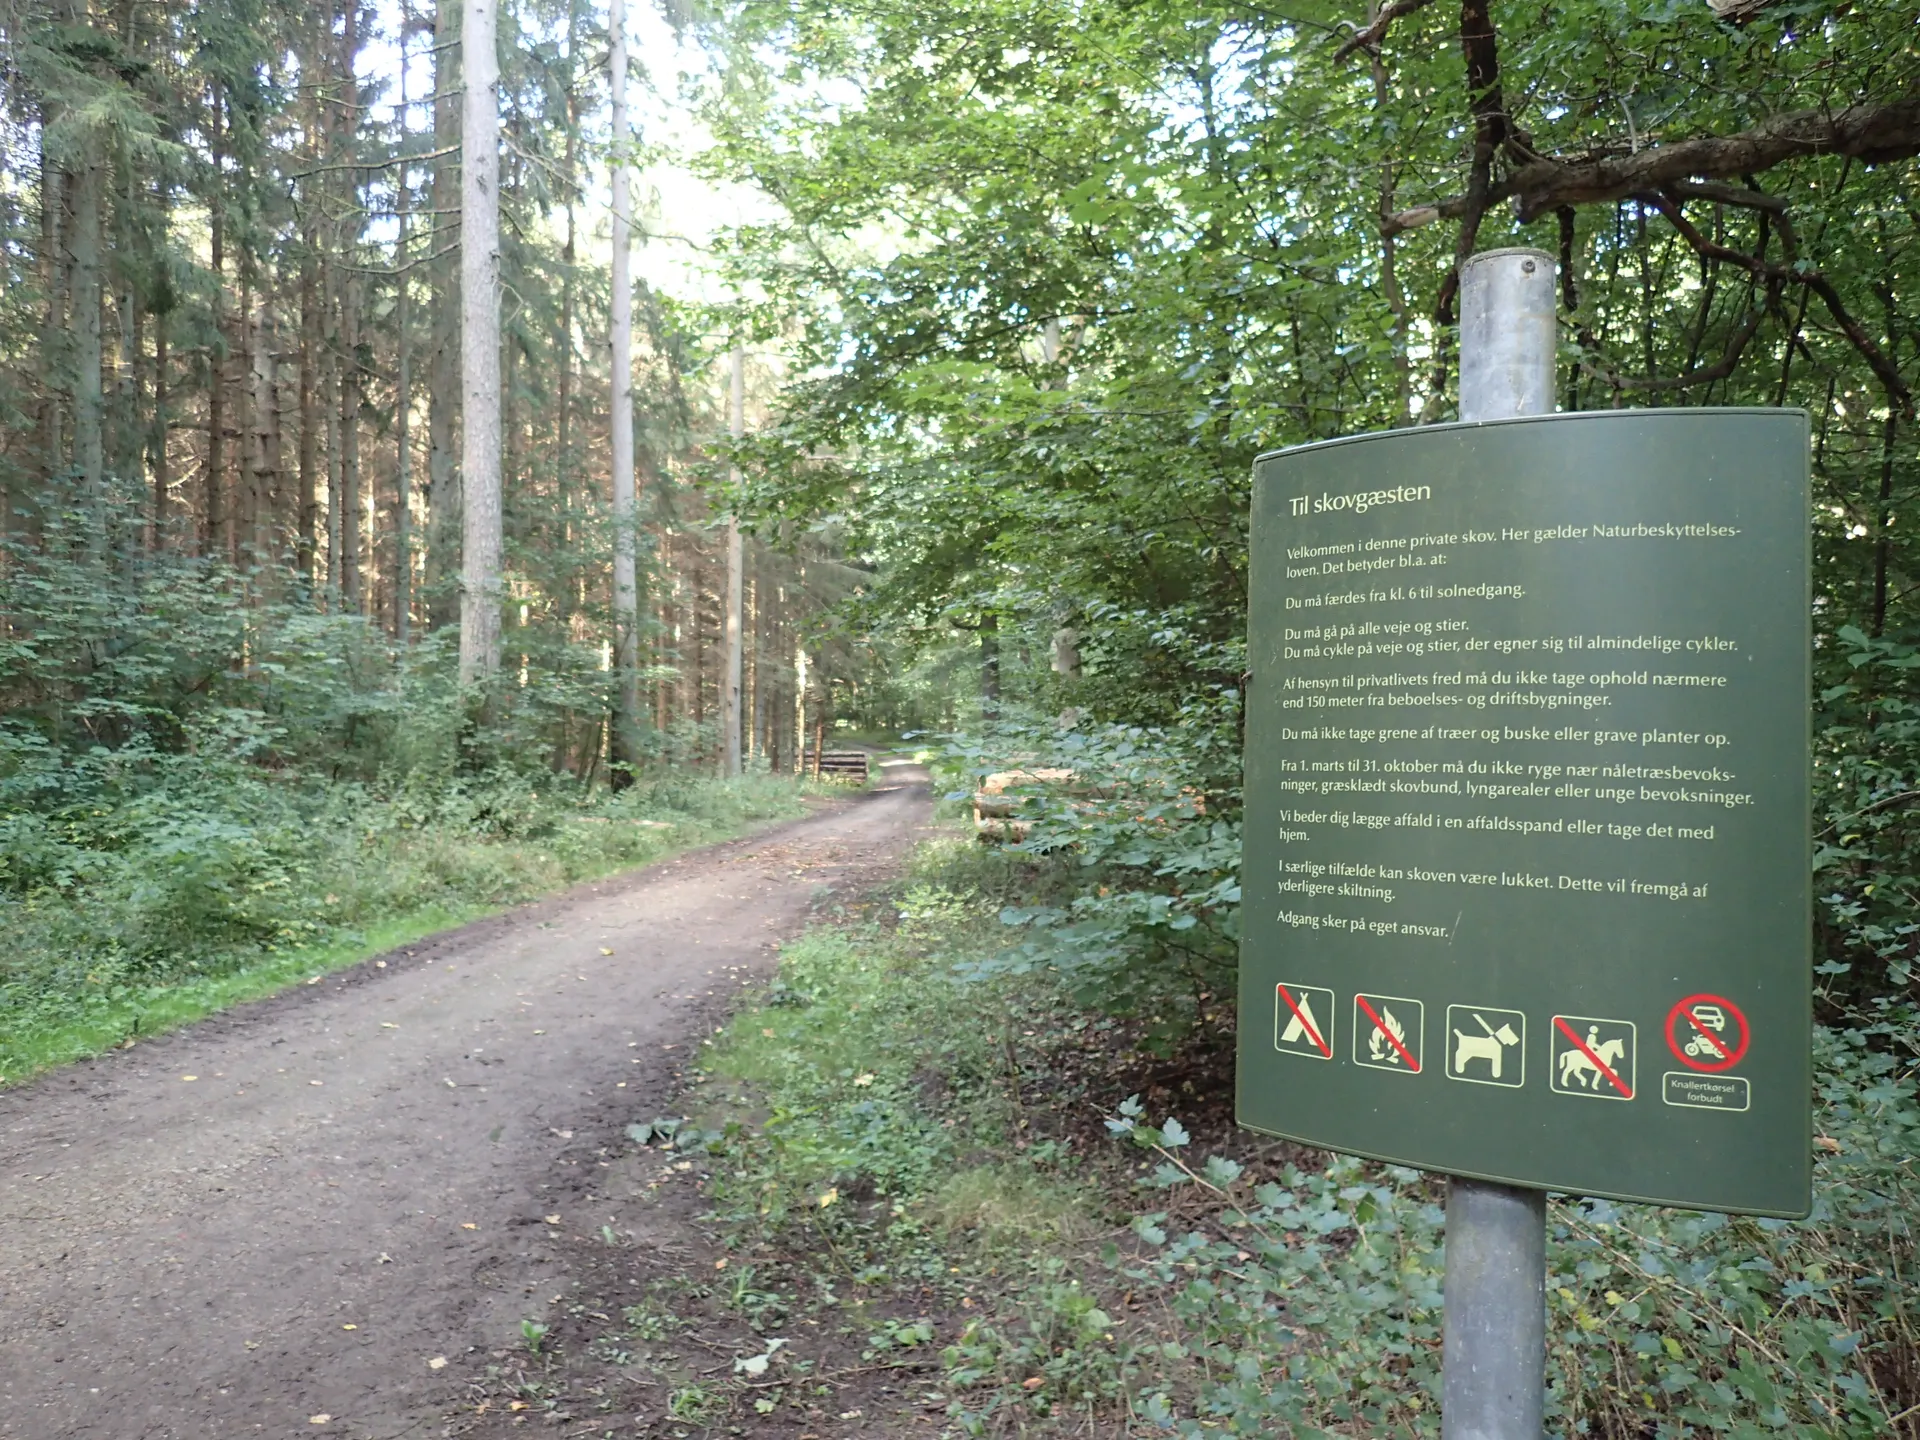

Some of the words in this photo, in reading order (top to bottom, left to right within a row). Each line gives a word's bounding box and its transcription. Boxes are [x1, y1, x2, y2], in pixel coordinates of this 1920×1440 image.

[1289, 496, 1308, 516] Til
[1314, 486, 1430, 513] skovgæsten
[1287, 544, 1354, 559] Velkommen
[1365, 538, 1406, 550] denne
[1411, 534, 1457, 550] private
[1462, 530, 1496, 543] skov.
[1502, 528, 1529, 540] Her
[1534, 525, 1588, 543] gælder
[1594, 523, 1741, 540] Naturbeskyttelses-
[1287, 567, 1319, 578] loven.
[1323, 562, 1343, 574] Det
[1347, 557, 1395, 573] betyder
[1400, 554, 1426, 567] bl.a.
[1430, 554, 1446, 565] at:
[1286, 598, 1301, 609] Du
[1305, 595, 1321, 607] må
[1325, 591, 1365, 605] færdes
[1370, 589, 1386, 601] fra
[1391, 588, 1404, 600] kl.
[1409, 588, 1416, 599] 6
[1420, 585, 1432, 598] til
[1438, 583, 1525, 599] solnedgang.
[1285, 629, 1300, 640] Du
[1304, 626, 1320, 638] må
[1324, 625, 1337, 641] gå
[1340, 624, 1354, 639] på
[1358, 622, 1380, 635] alle
[1384, 621, 1410, 636] veje
[1415, 623, 1432, 635] og
[1436, 619, 1469, 631] stier.
[1285, 647, 1300, 658] Du
[1304, 645, 1320, 657] må
[1323, 643, 1354, 659] cykle
[1358, 642, 1372, 658] på
[1376, 641, 1402, 656] veje
[1407, 643, 1423, 656] og
[1428, 639, 1460, 652] stier,
[1465, 637, 1489, 650] der
[1494, 640, 1537, 654] egner
[1542, 637, 1563, 653] sig
[1568, 636, 1582, 649] til
[1588, 635, 1681, 653] almindelige
[1686, 636, 1737, 653] cykler.
[1283, 677, 1295, 689] Af
[1298, 677, 1338, 691] hensyn
[1342, 675, 1353, 687] til
[1358, 673, 1428, 690] privatlivets
[1433, 671, 1461, 684] fred
[1466, 672, 1487, 684] må
[1492, 671, 1510, 684] du
[1517, 671, 1547, 684] ikke
[1553, 673, 1585, 688] tage
[1590, 671, 1647, 688] ophold
[1653, 676, 1726, 686] nærmere
[1283, 696, 1303, 708] end
[1307, 696, 1325, 707] 150
[1329, 696, 1364, 706] meter
[1368, 693, 1384, 705] fra
[1389, 692, 1463, 705] beboelses-
[1467, 696, 1485, 709] og
[1490, 691, 1611, 709] driftsbygninger.
[1283, 728, 1298, 739] Du
[1301, 727, 1317, 739] må
[1322, 727, 1345, 739] ikke
[1349, 729, 1375, 743] tage
[1379, 730, 1417, 743] grene
[1421, 726, 1434, 738] af
[1438, 728, 1477, 739] træer
[1481, 730, 1499, 743] og
[1505, 726, 1549, 740] buske
[1555, 727, 1589, 740] eller
[1594, 731, 1637, 745] grave
[1643, 729, 1700, 746] planter
[1705, 735, 1730, 748] op.
[1282, 760, 1296, 771] Fra
[1300, 760, 1308, 771] 1.
[1312, 761, 1344, 771] marts
[1348, 759, 1359, 771] til
[1363, 760, 1380, 771] 31.
[1384, 759, 1438, 772] oktober
[1443, 760, 1463, 773] må
[1468, 760, 1486, 773] du
[1492, 761, 1523, 774] ikke
[1529, 766, 1561, 779] ryge
[1567, 766, 1598, 776] nær
[1603, 764, 1735, 781] nåletræsbevoks-
[1281, 779, 1318, 794] ninger,
[1322, 779, 1386, 794] græsklædt
[1390, 779, 1461, 795] skovbund,
[1467, 781, 1550, 799] lyngarealer
[1555, 784, 1590, 797] eller
[1596, 789, 1635, 803] unge
[1641, 786, 1754, 808] bevoksninger.
[1280, 810, 1290, 821] Vi
[1294, 810, 1327, 823] beder
[1330, 811, 1349, 828] dig
[1353, 812, 1390, 829] lægge
[1394, 813, 1432, 827] affald
[1445, 818, 1462, 828] en
[1467, 816, 1562, 835] affaldsspand
[1568, 820, 1603, 834] eller
[1608, 823, 1641, 840] tage
[1647, 823, 1672, 837] det
[1678, 826, 1713, 839] med
[1280, 828, 1309, 843] hjem.
[1278, 879, 1334, 897] yderligere
[1338, 883, 1395, 903] skiltning.
[1285, 861, 1325, 877] særlige
[1329, 863, 1375, 877] tilfælde
[1380, 865, 1402, 878] kan
[1407, 867, 1455, 882] skoven
[1460, 874, 1497, 885] være
[1502, 872, 1553, 888] lukket.
[1559, 876, 1602, 891] Dette
[1607, 879, 1625, 892] vil
[1631, 879, 1687, 900] fremgå
[1693, 883, 1708, 897] af
[1277, 911, 1319, 929] Adgang
[1322, 914, 1347, 928] sker
[1351, 918, 1365, 933] på
[1369, 922, 1397, 936] eget
[1401, 925, 1448, 937] ansvar.
[1687, 1092, 1723, 1103] forbudt
